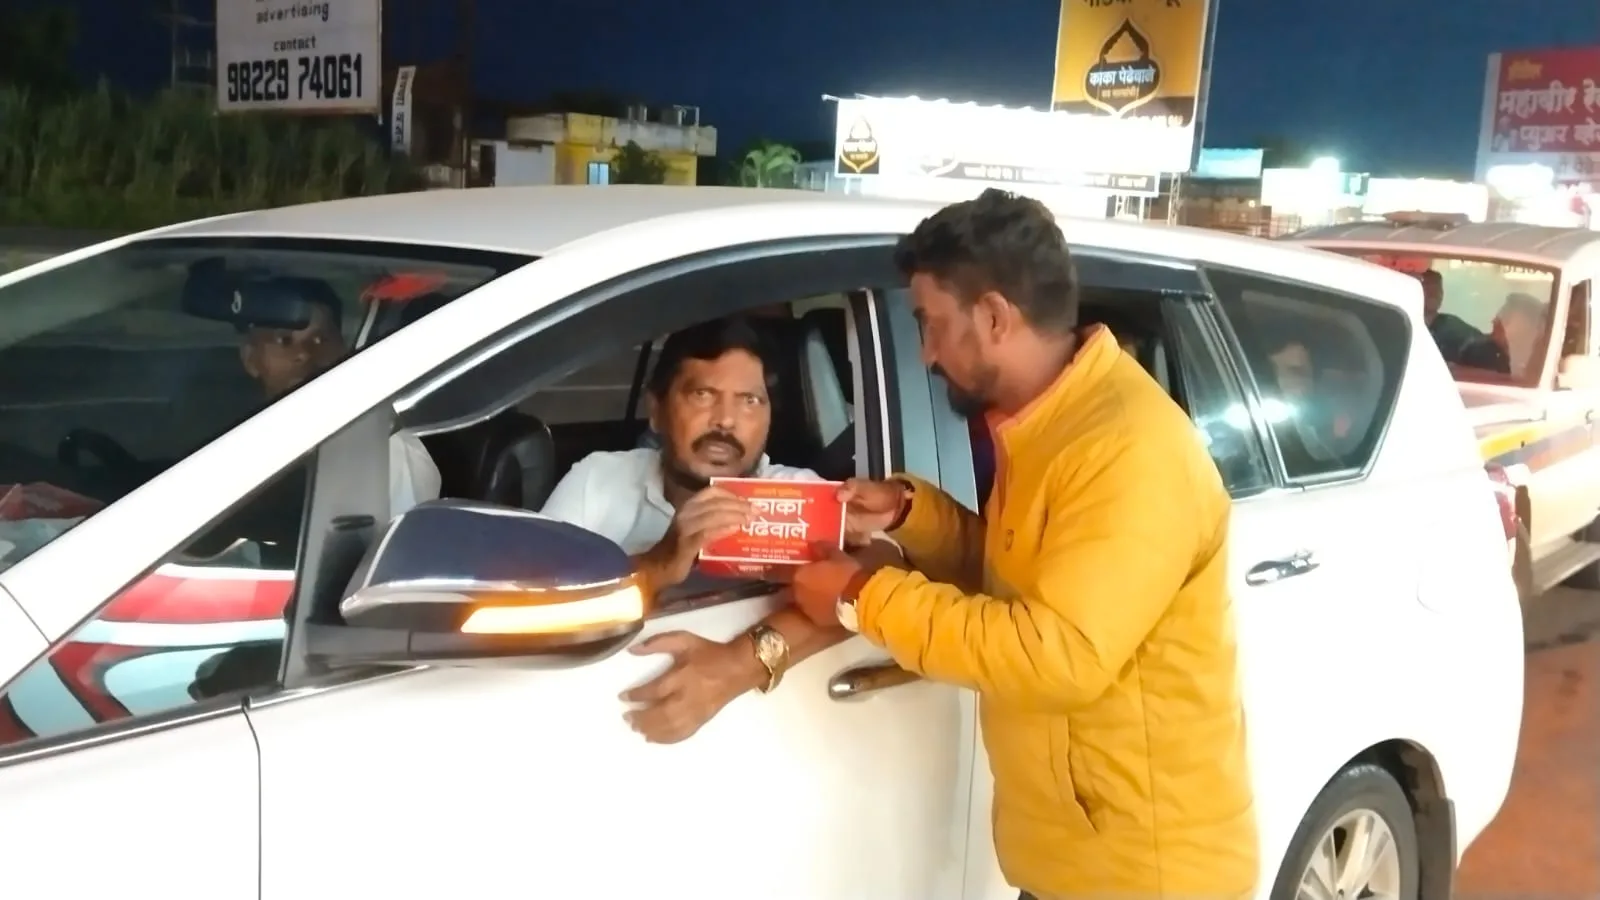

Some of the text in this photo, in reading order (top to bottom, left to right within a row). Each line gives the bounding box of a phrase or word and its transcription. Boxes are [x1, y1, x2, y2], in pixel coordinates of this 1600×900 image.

[256, 3, 329, 24] advertising
[274, 36, 316, 52] contact
[227, 53, 362, 102] 98229 74061
[1089, 64, 1156, 86] काका पेढेवाले
[1499, 79, 1577, 119] महावीर
